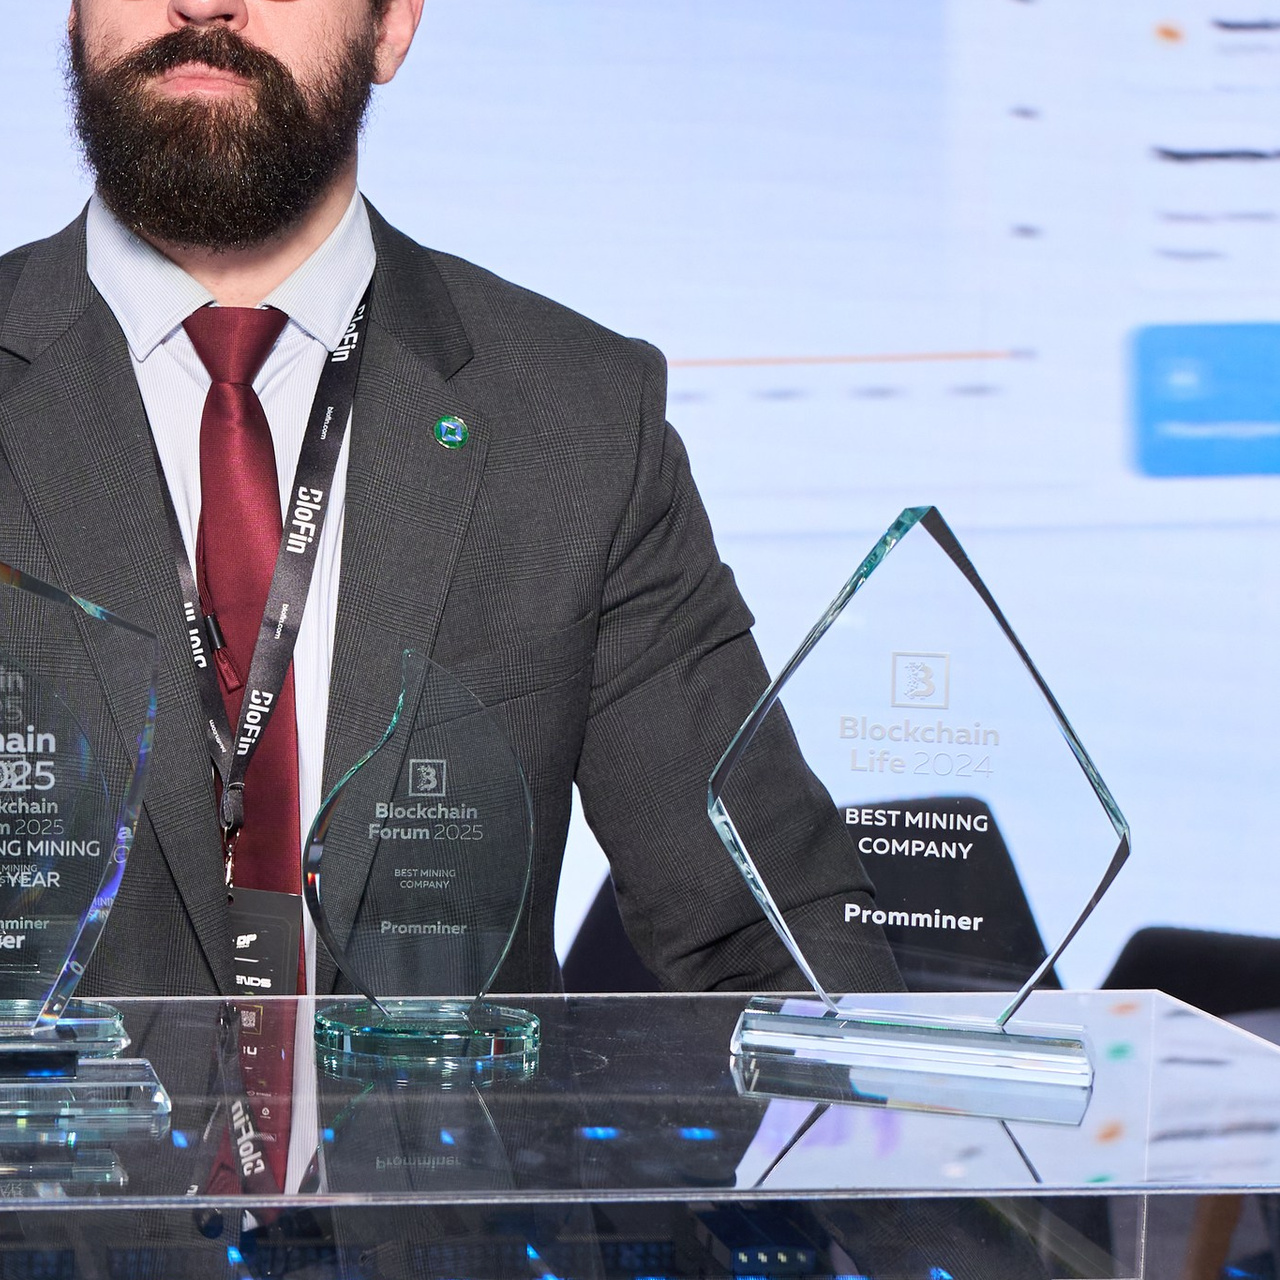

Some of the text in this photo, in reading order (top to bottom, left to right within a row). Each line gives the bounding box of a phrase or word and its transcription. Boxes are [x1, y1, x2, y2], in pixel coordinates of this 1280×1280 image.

[286, 486, 323, 554] BloFin
[237, 689, 274, 756] BloFin
[839, 714, 1000, 746] Blockchain
[850, 748, 995, 778] Life 2024
[375, 802, 478, 820] Blockchain
[845, 808, 988, 832] BEST MINING
[15, 818, 64, 835] 2025
[368, 824, 483, 841] Forum 2025
[27, 840, 101, 858] MINING
[858, 836, 974, 860] COMPANY
[6, 872, 61, 888] YEAR
[394, 868, 456, 878] BEST MINING
[400, 879, 450, 889] COMPANY
[844, 903, 983, 931] Promminer
[380, 920, 467, 935] Promminer
